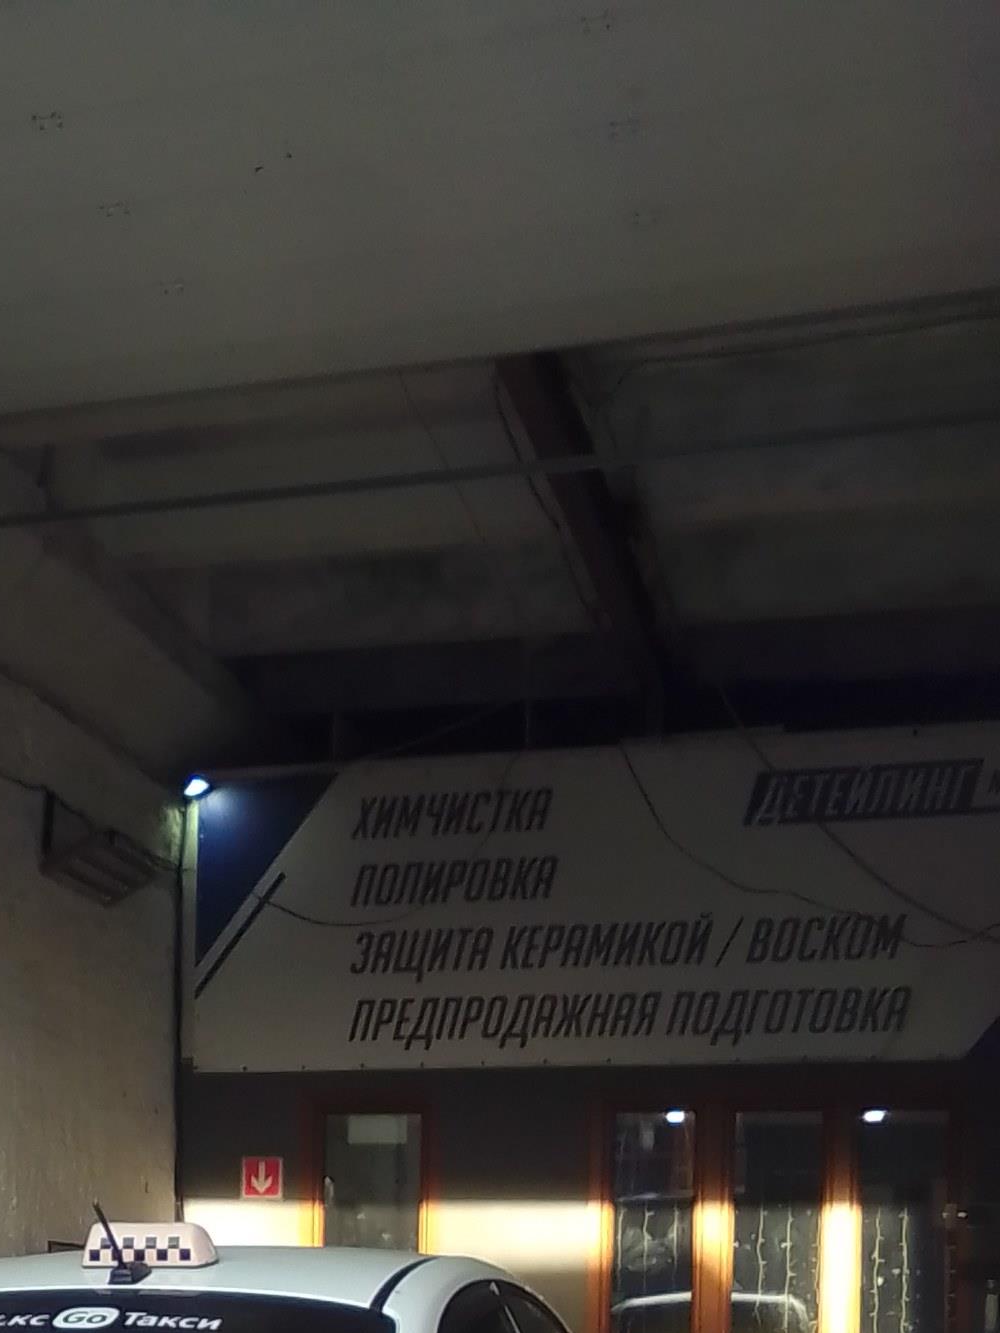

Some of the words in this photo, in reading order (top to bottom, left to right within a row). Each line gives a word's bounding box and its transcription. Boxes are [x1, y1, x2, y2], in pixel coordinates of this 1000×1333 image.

[352, 787, 553, 840] ХИМЧИСТКА
[753, 767, 973, 824] ДЕТЕЙЛИНГ
[350, 855, 559, 907] ПОЛИРОВКА
[350, 926, 494, 982] ЗАЩИТА
[499, 912, 714, 970] КЕРАМИКОЙ
[746, 913, 908, 963] ВОСКОМ
[348, 992, 662, 1051] ПРЕДПРОДАЖНАЯ
[665, 985, 912, 1047] ПОДГОТОВКА
[61, 1310, 109, 1325] Go
[124, 1311, 223, 1331] Такси
